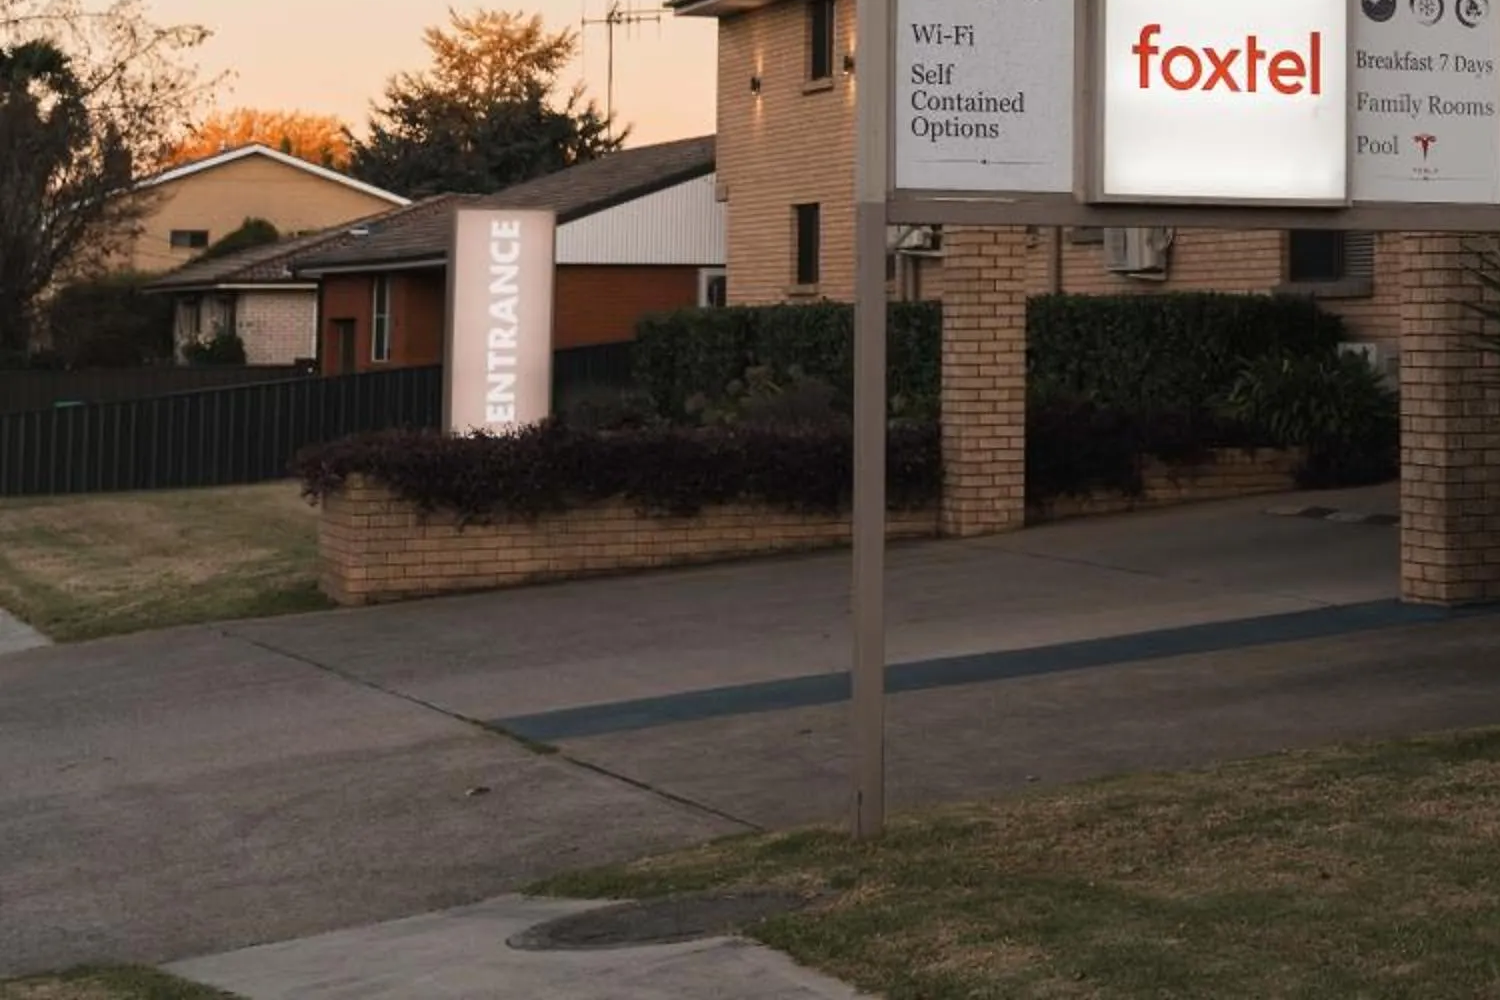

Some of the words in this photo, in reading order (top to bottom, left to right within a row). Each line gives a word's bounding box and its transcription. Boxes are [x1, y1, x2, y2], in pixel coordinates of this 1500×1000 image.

[911, 23, 974, 47] Wi-Fi
[1131, 23, 1321, 96] foxtel
[1355, 49, 1433, 72] Breakfast
[1439, 53, 1450, 71] 7
[1454, 55, 1494, 76] Days
[911, 63, 954, 86] Self
[911, 89, 1025, 113] Contained
[1356, 92, 1421, 119] Family
[1428, 95, 1495, 117] Rooms
[911, 115, 1000, 143] Options
[1356, 135, 1400, 155] Pool
[485, 219, 521, 423] ENTRANCE
